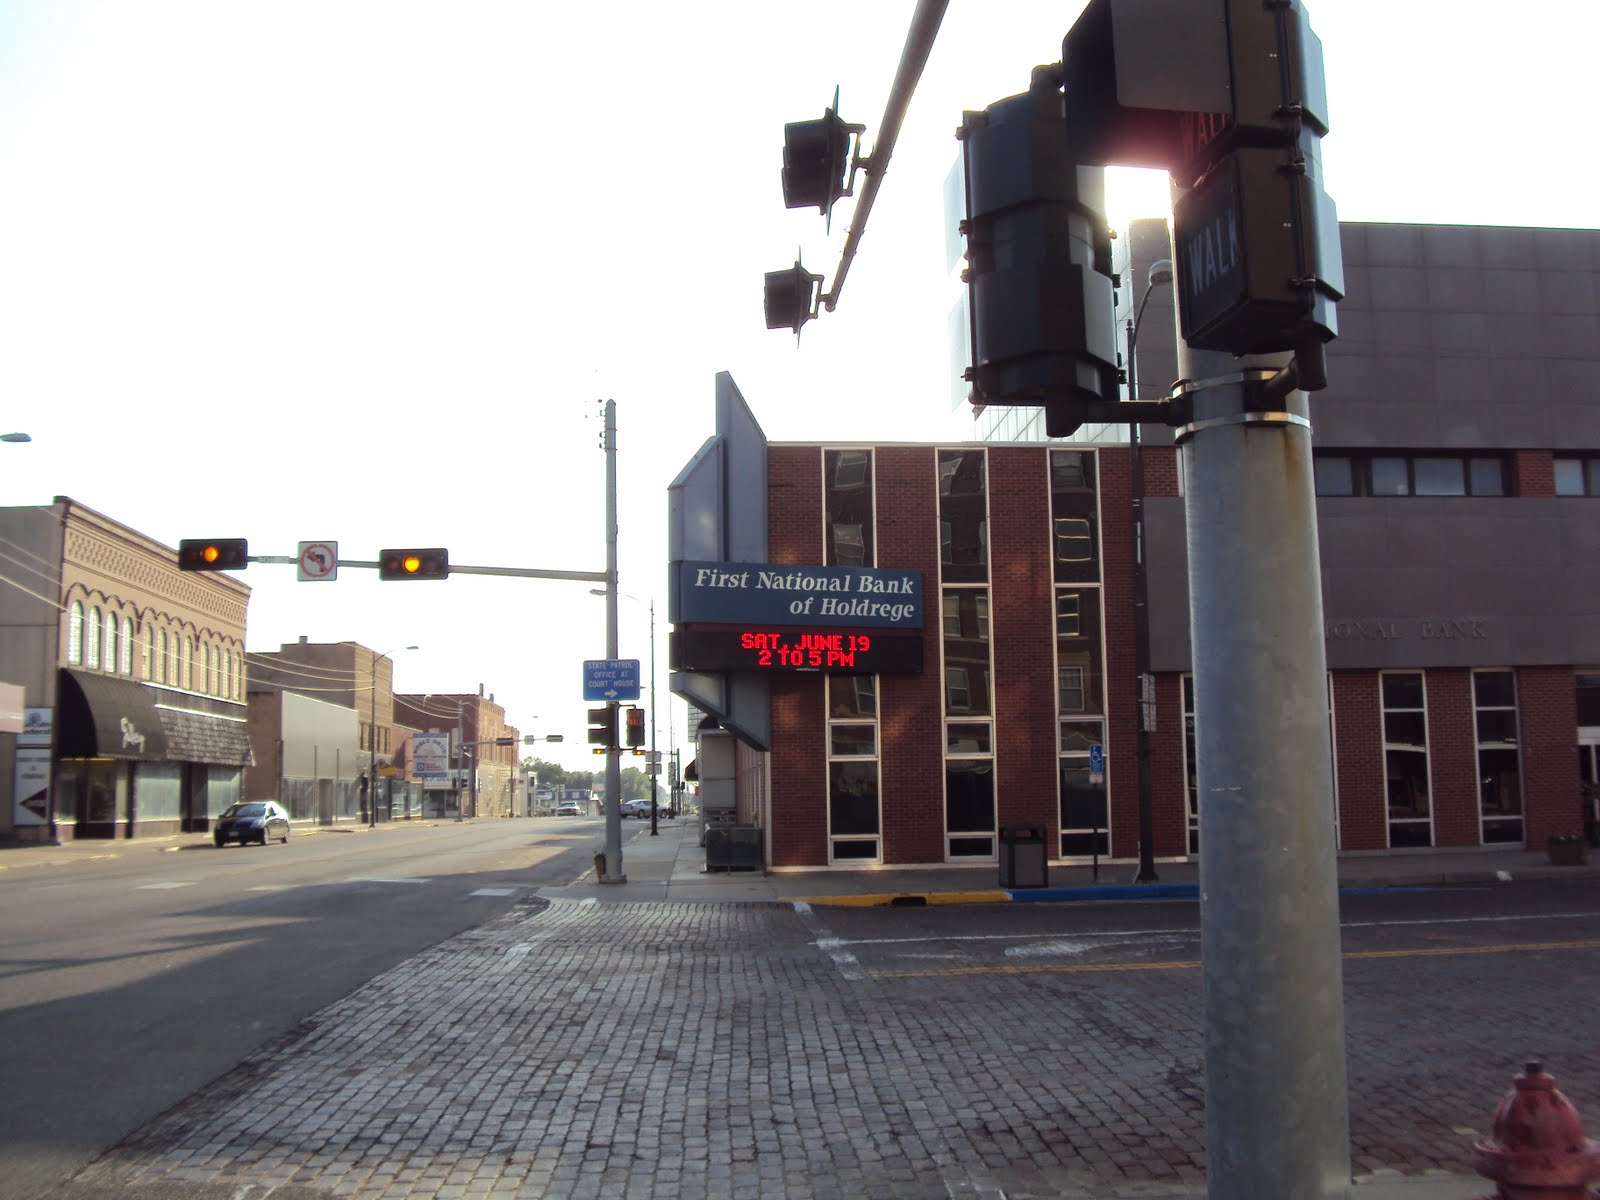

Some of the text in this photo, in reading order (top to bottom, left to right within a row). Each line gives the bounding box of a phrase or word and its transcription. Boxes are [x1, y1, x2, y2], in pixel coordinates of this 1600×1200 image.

[1188, 207, 1239, 297] WALK
[694, 568, 914, 594] First National Bank
[789, 596, 915, 621] of Holdrege
[1325, 618, 1488, 641] IONAL BANK
[794, 634, 843, 651] JUNE
[848, 635, 871, 652] 19
[610, 661, 633, 669] PATROL
[759, 650, 772, 666] 2
[809, 651, 822, 666] 5
[827, 651, 855, 667] PM
[588, 680, 608, 688] COURT
[594, 671, 616, 679] OFFICE
